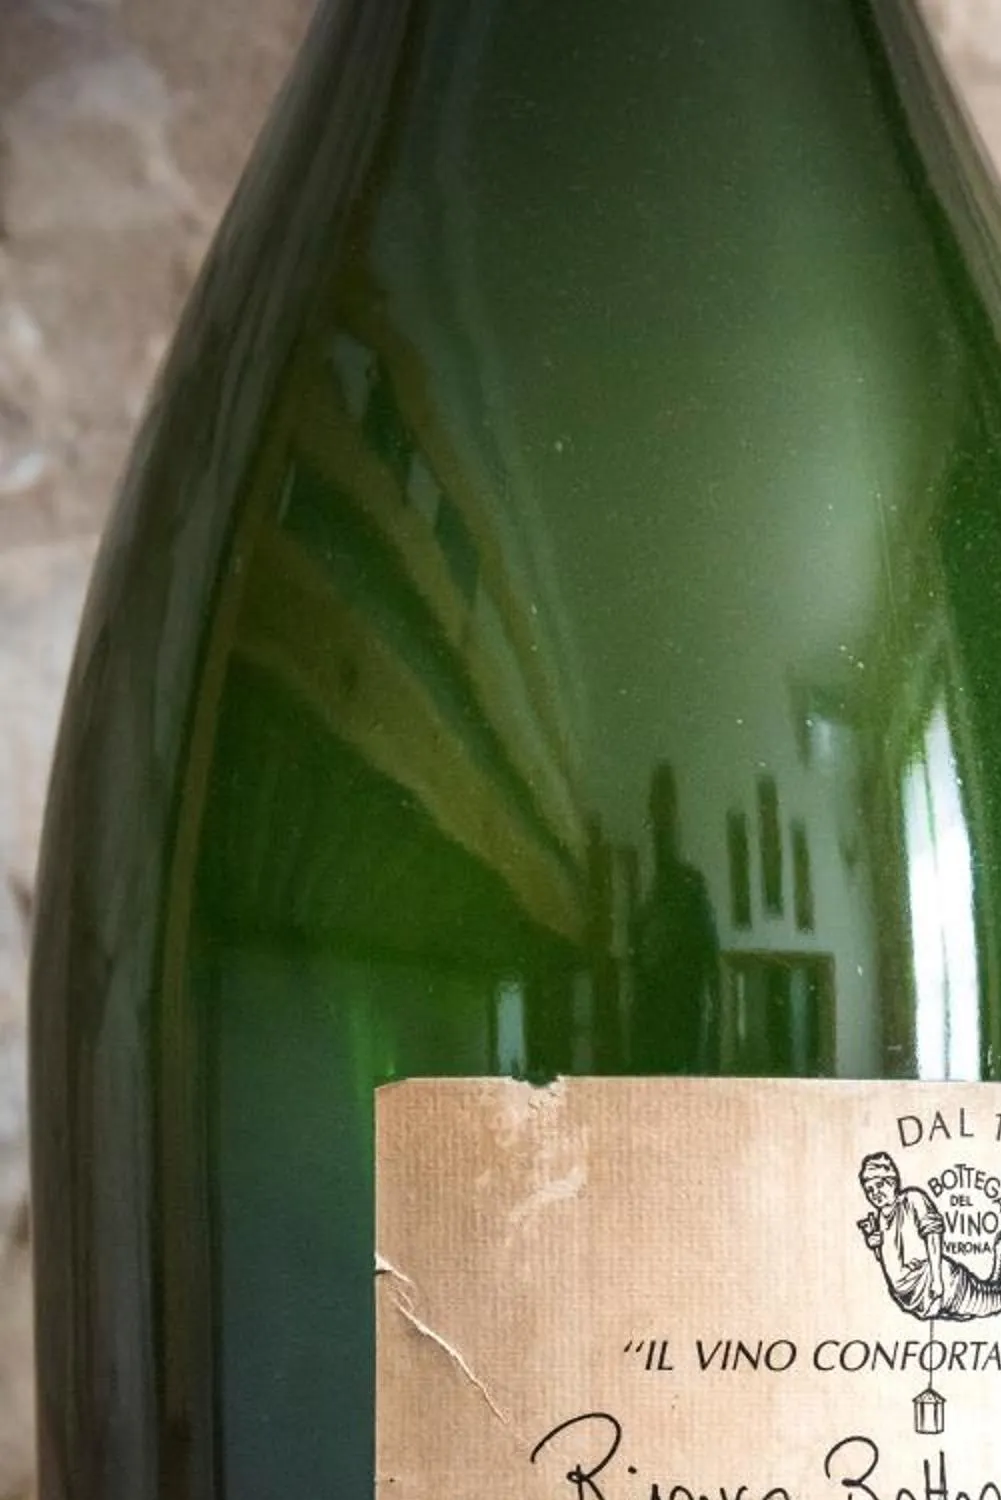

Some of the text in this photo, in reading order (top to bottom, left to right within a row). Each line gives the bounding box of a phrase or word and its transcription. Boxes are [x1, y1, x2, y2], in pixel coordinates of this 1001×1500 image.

[896, 1107, 974, 1148] DAL
[949, 1194, 974, 1207] DEL
[945, 1209, 999, 1237] VINO
[942, 1241, 992, 1257] VERONA
[696, 1339, 796, 1372] VINO
